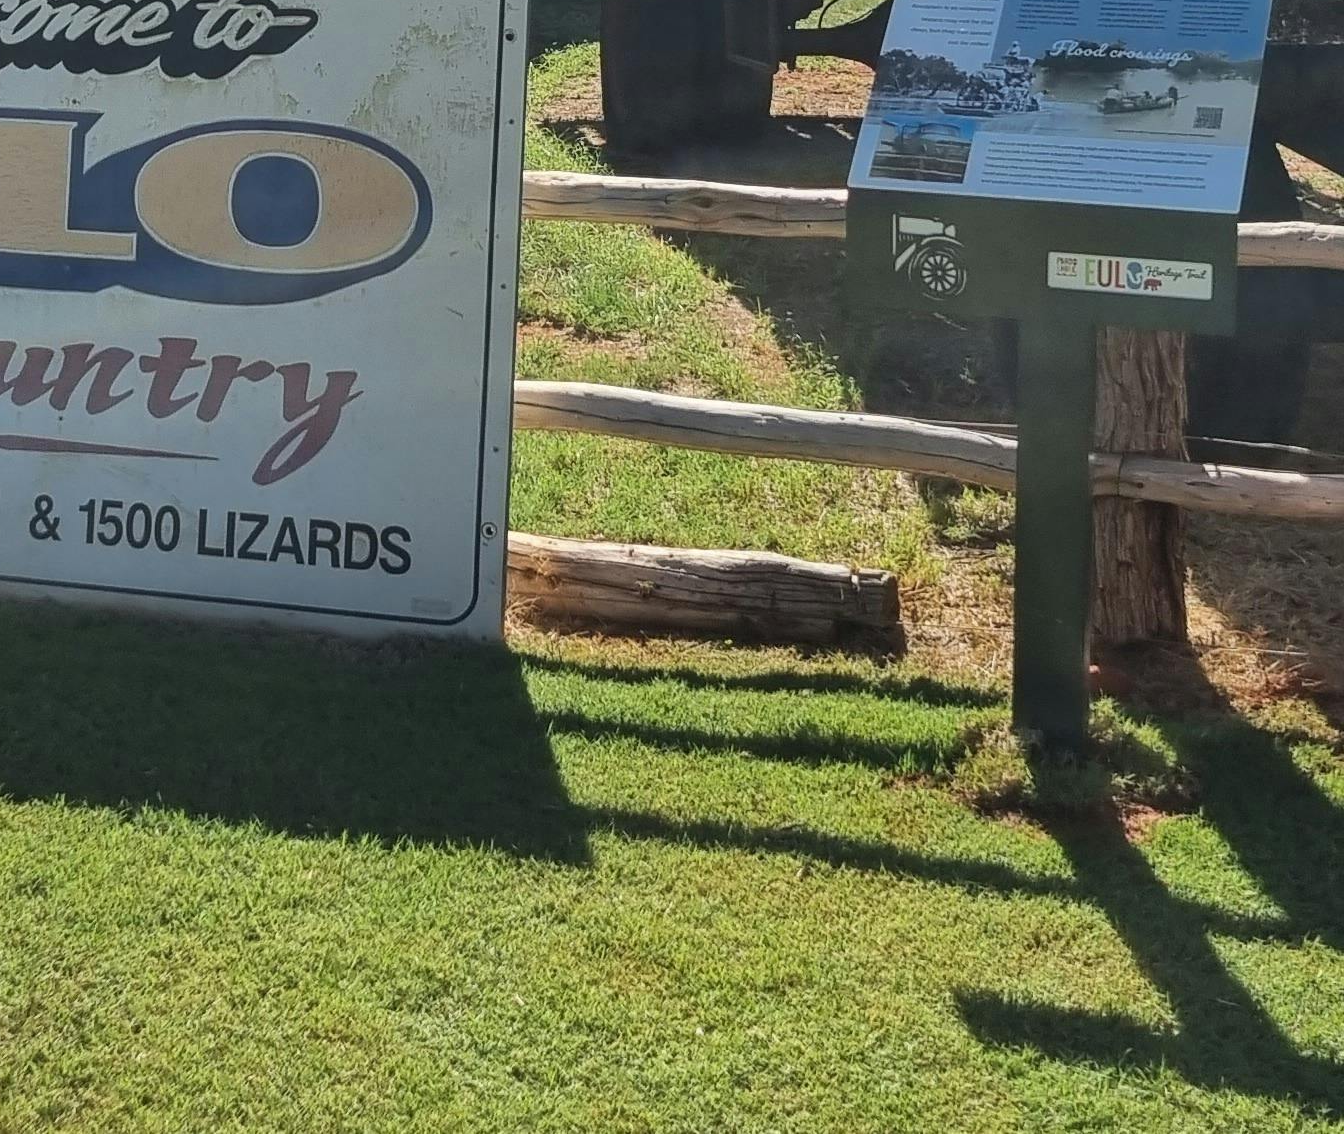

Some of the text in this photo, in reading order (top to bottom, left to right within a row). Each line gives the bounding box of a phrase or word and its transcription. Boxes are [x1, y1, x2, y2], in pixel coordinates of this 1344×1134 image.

[1049, 39, 1194, 67] Flood crossings
[28, 494, 62, 543] &
[78, 498, 181, 552] 1500
[196, 508, 413, 576] LIZARDS
